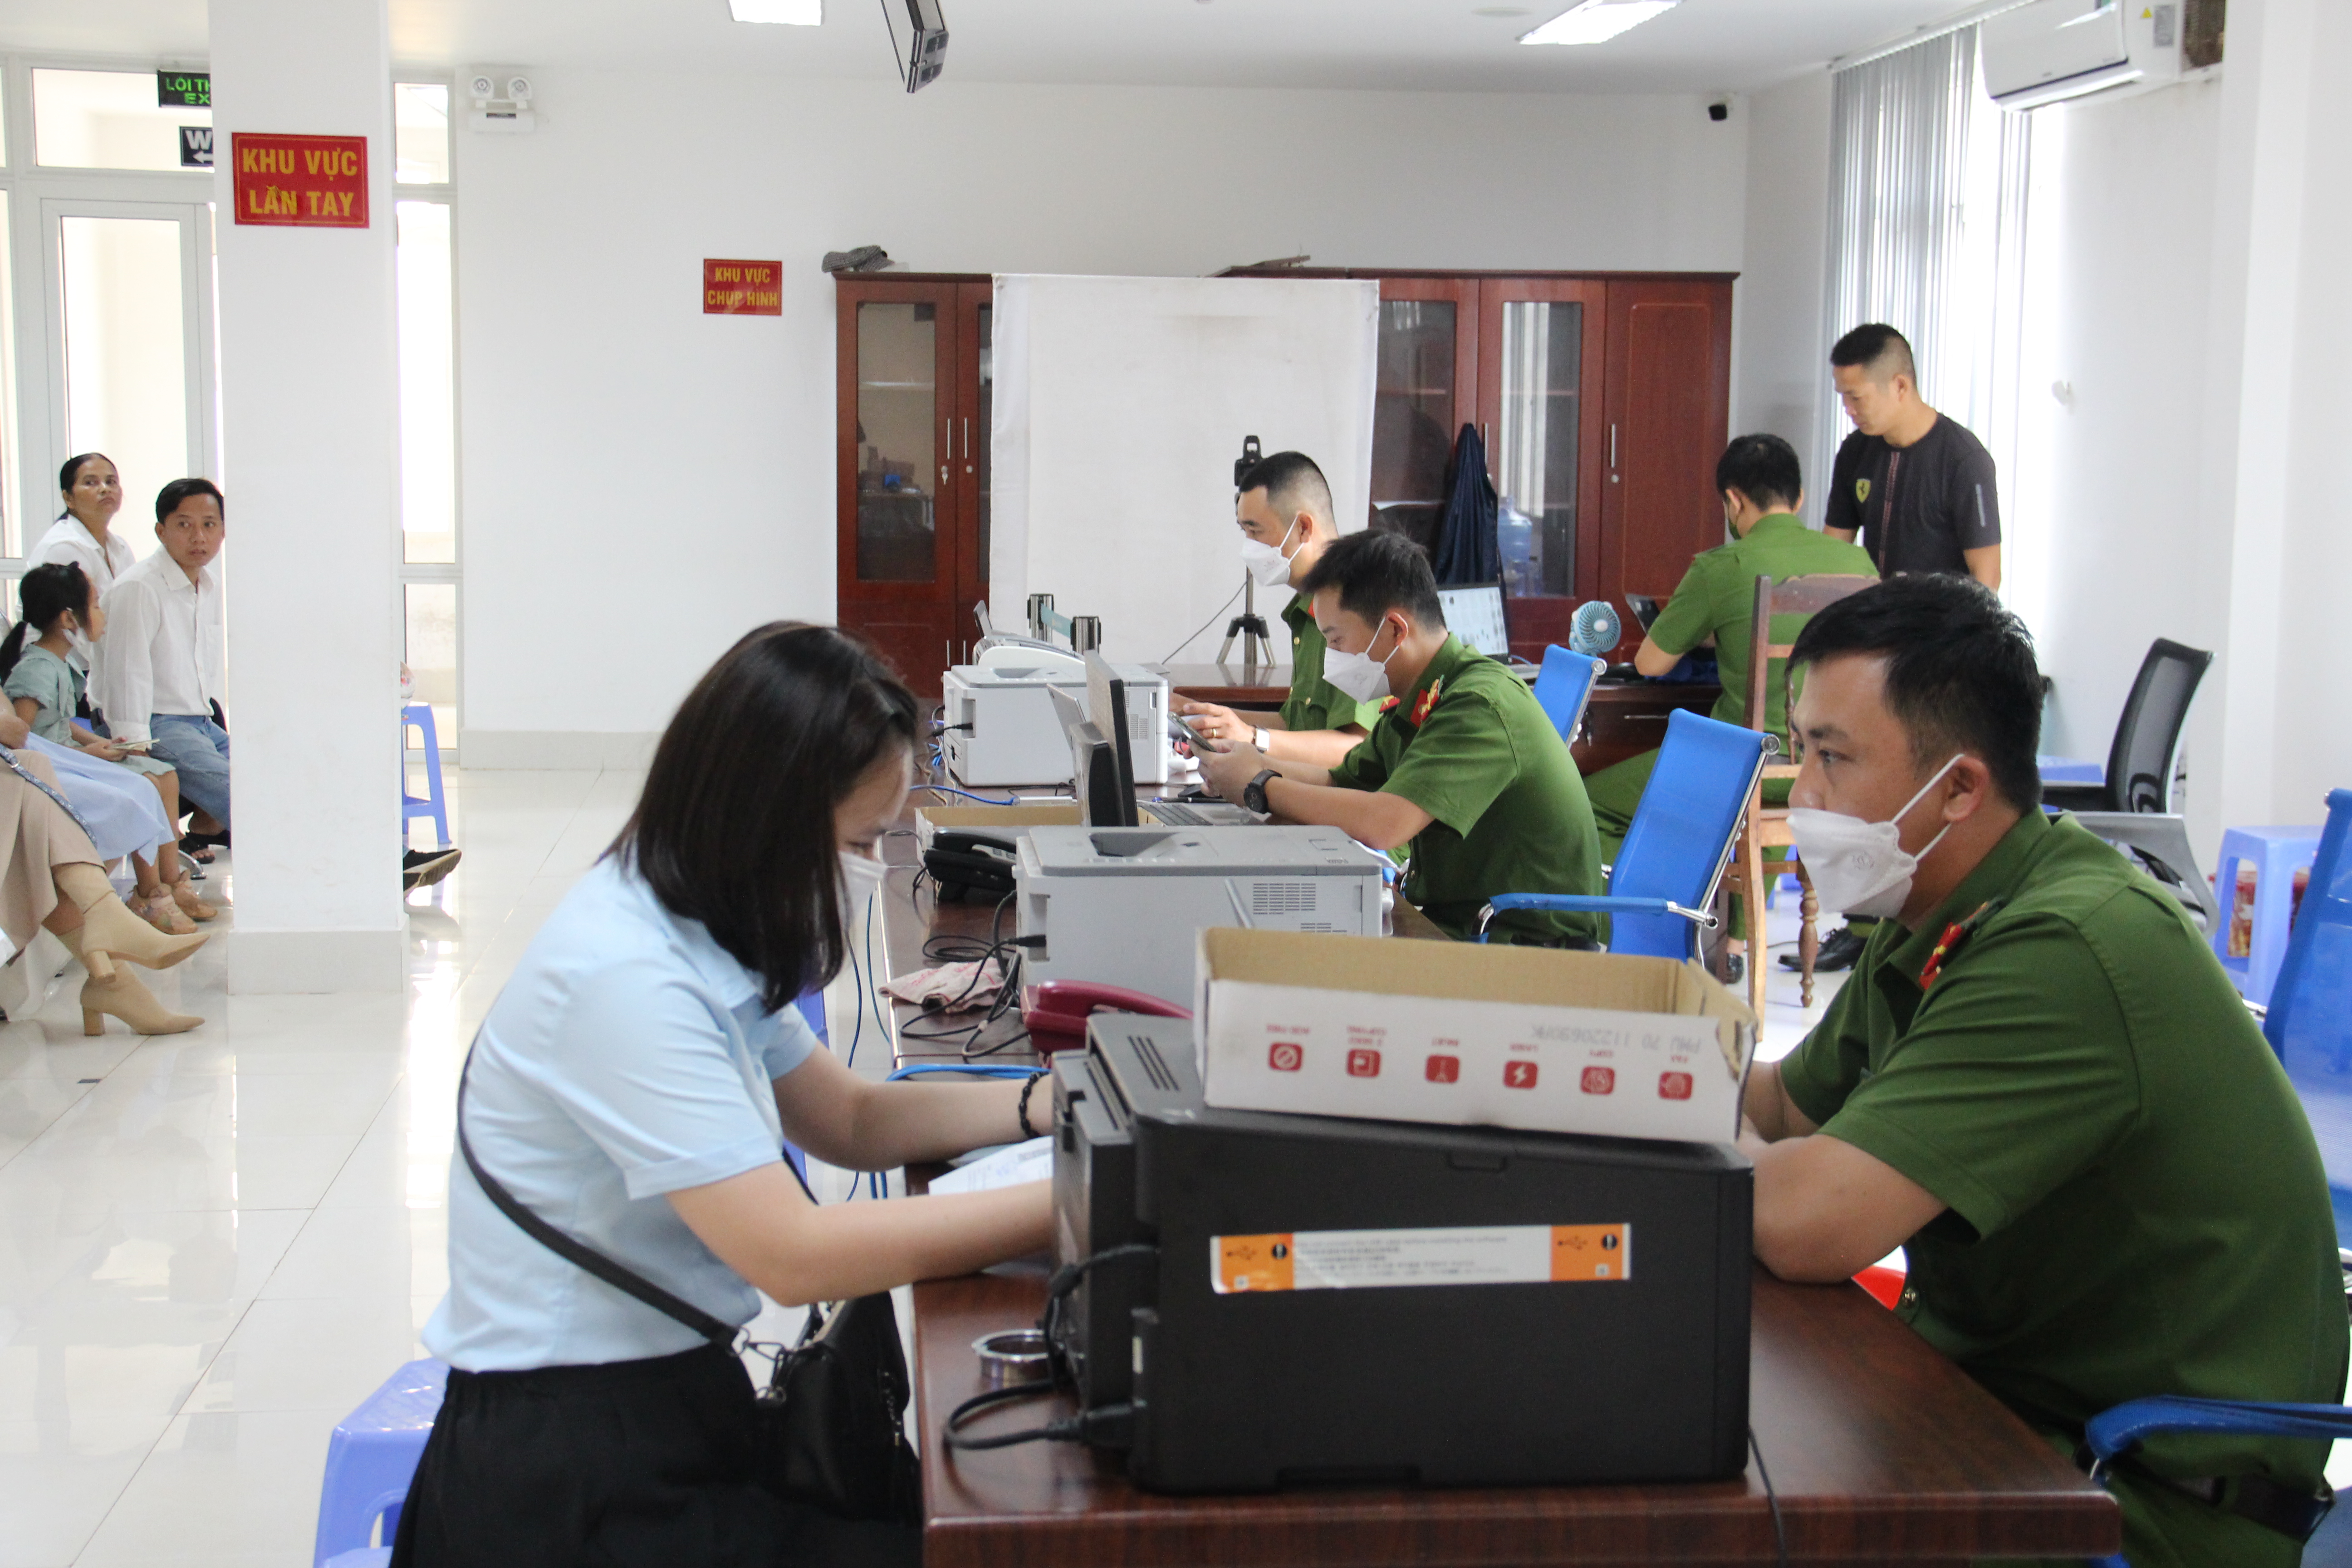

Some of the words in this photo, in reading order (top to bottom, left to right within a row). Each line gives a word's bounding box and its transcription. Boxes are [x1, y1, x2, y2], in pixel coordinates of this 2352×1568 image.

[184, 93, 211, 104] EX
[185, 130, 212, 150] W
[243, 148, 295, 174] KHU
[304, 147, 358, 181] VỰC
[306, 191, 354, 216] TAY
[715, 267, 741, 283] KHU
[745, 267, 771, 286] VỰC
